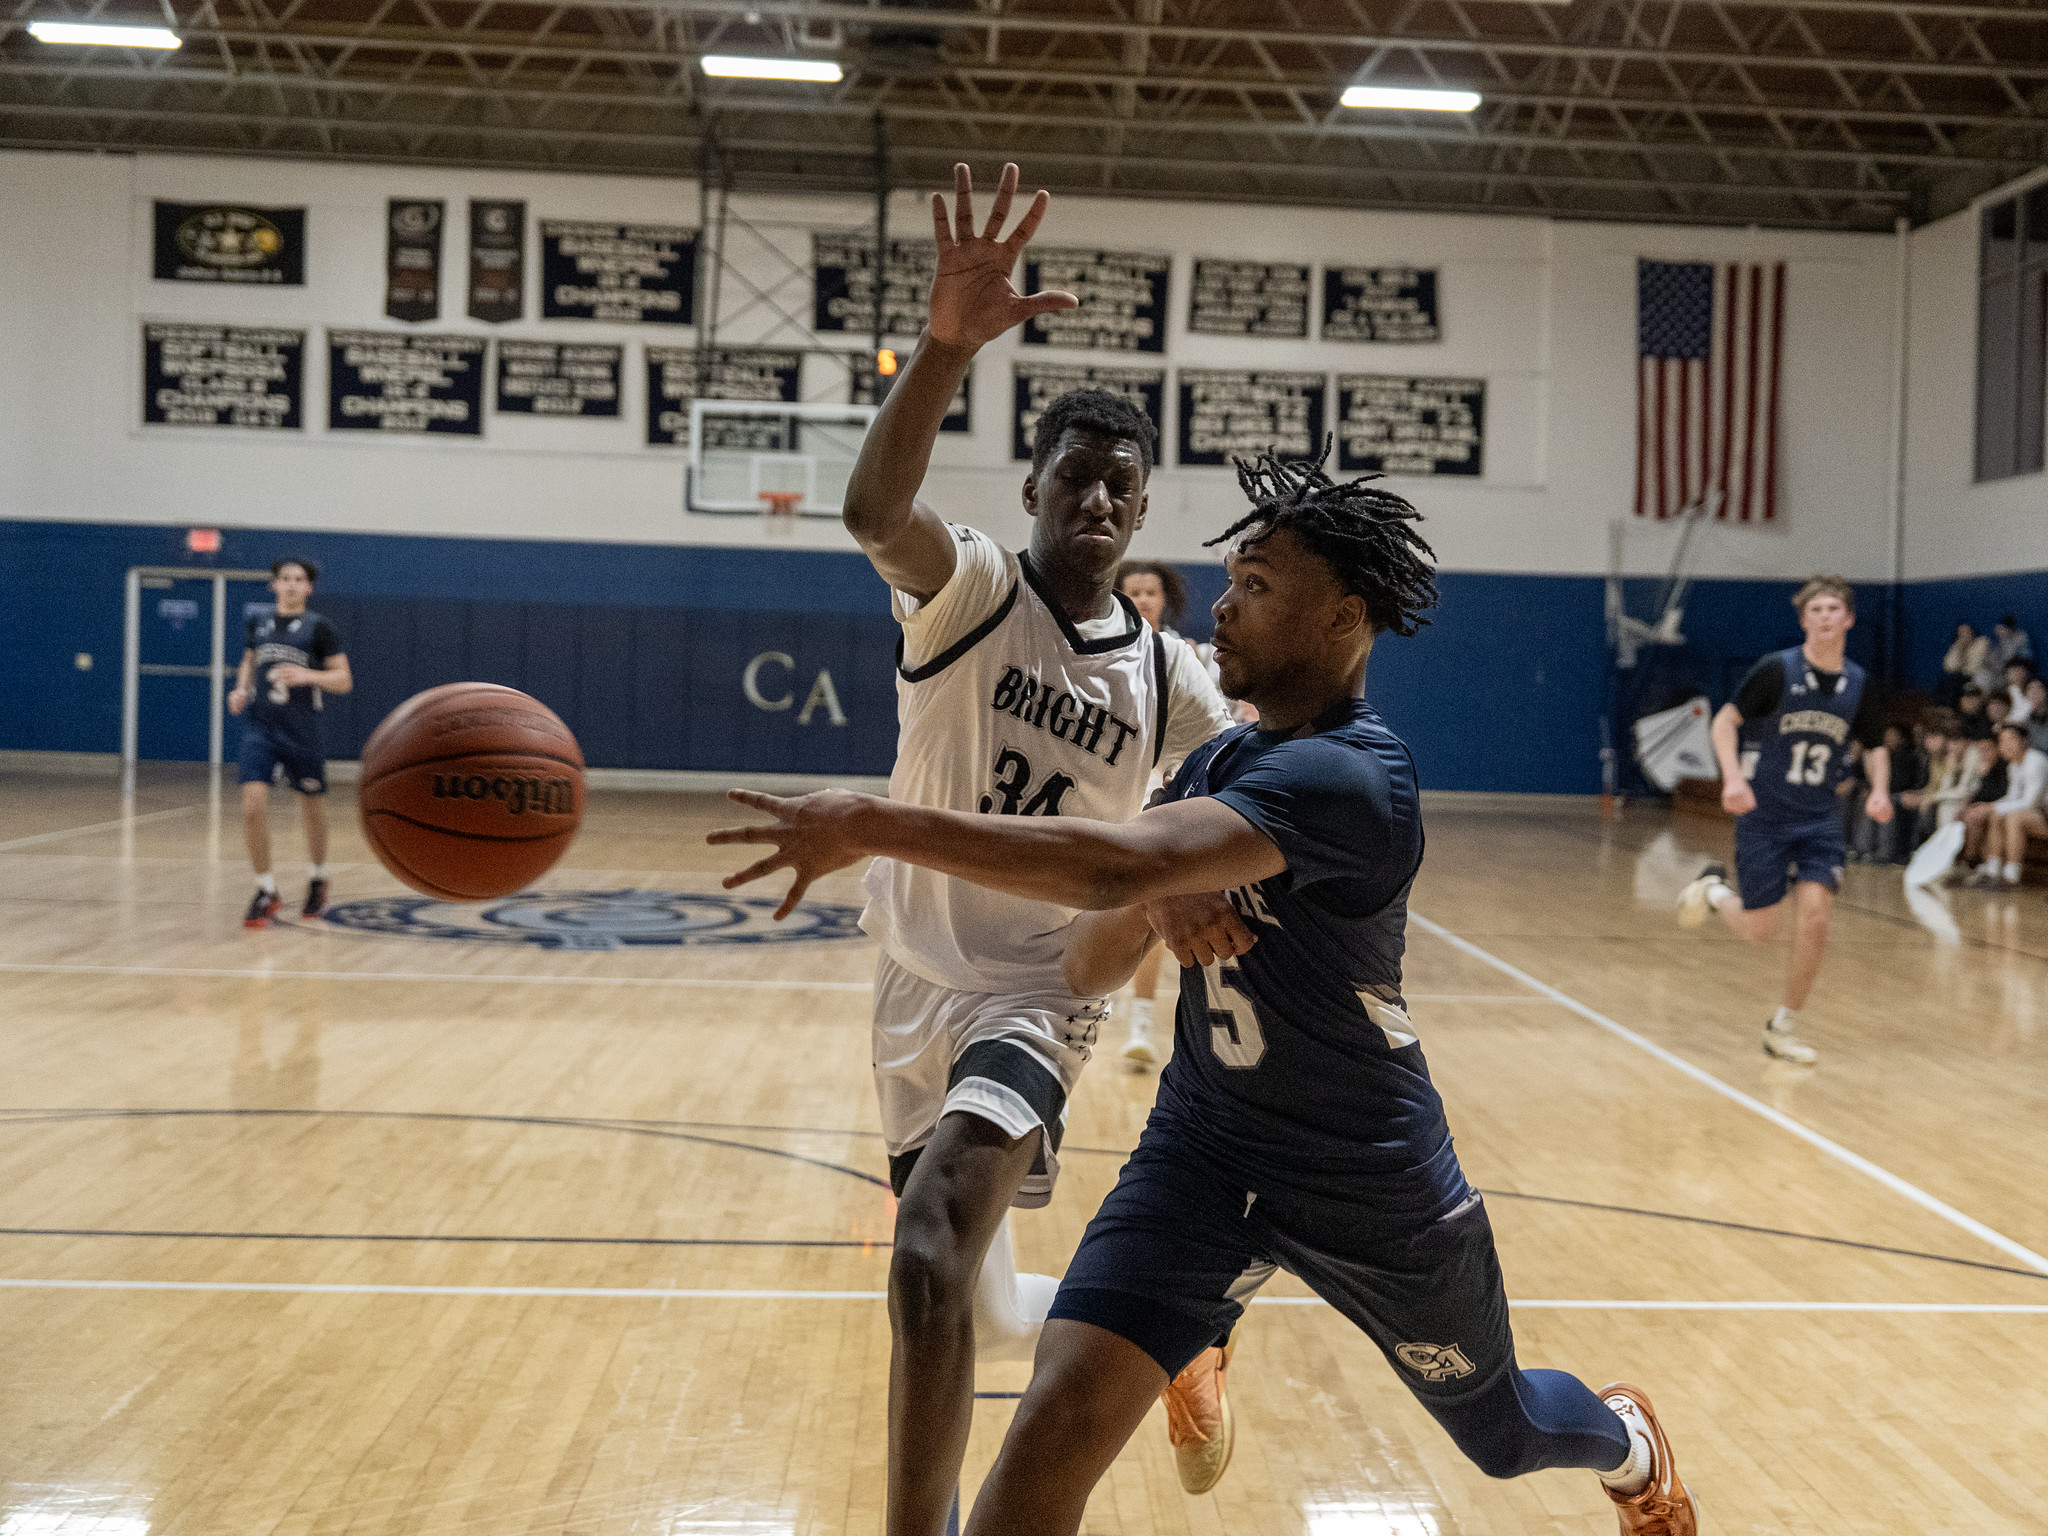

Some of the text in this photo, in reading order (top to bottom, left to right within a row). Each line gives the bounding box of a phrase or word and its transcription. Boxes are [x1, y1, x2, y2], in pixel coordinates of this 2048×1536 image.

[554, 285, 682, 311] CHAMPIONS
[156, 389, 290, 413] CHAMPIONS
[341, 395, 469, 421] CHAMPIONS
[992, 665, 1139, 767] BRIGHT
[1786, 741, 1832, 786] 13
[1203, 954, 1269, 1070] 5
